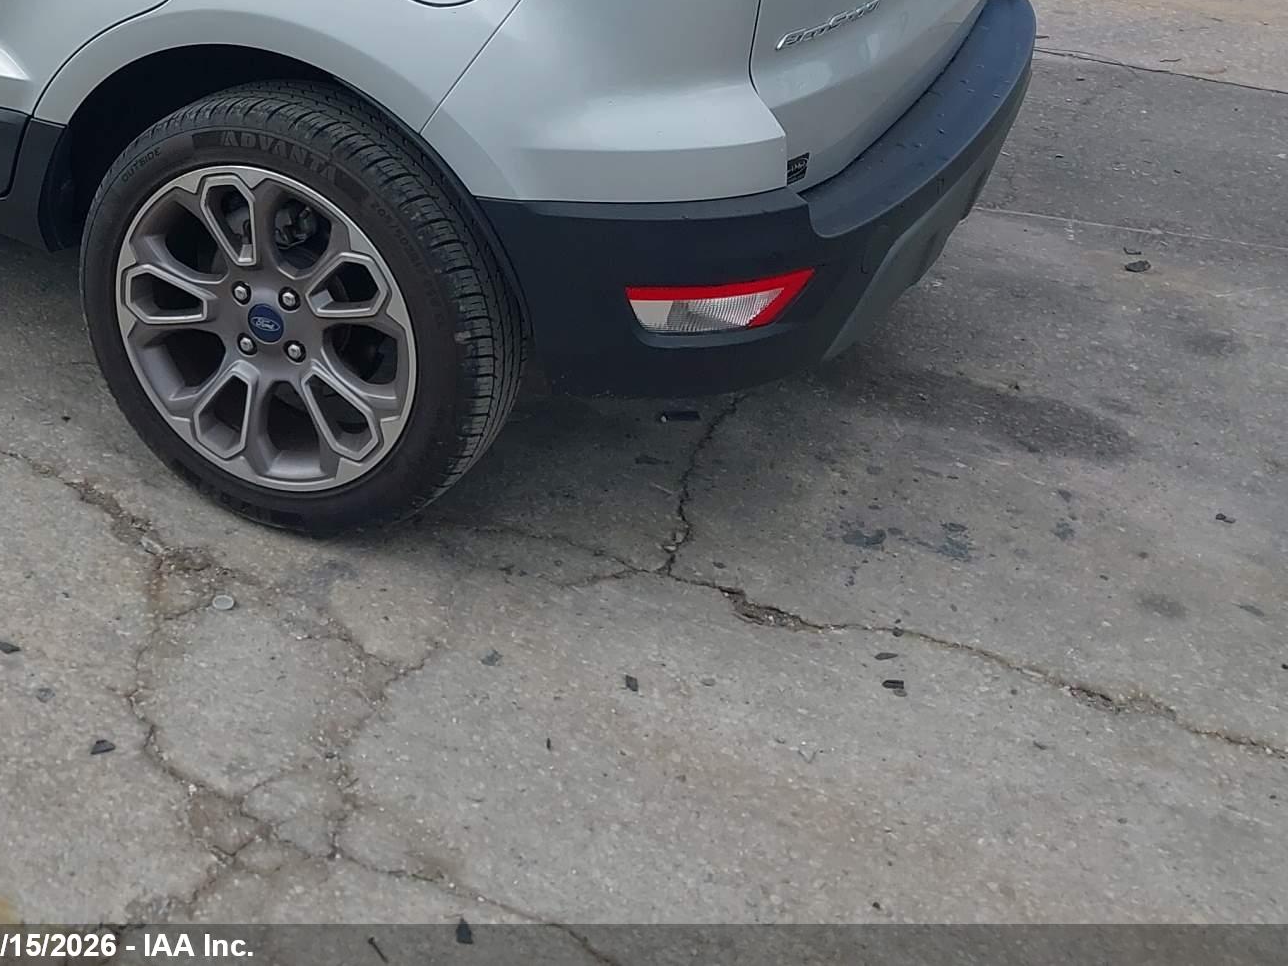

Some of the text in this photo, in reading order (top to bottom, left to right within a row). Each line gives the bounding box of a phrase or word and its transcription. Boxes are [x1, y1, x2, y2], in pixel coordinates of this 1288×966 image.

[121, 146, 162, 183] OUTSIDE
[220, 130, 338, 184] ADVANTA
[253, 317, 278, 331] Ford
